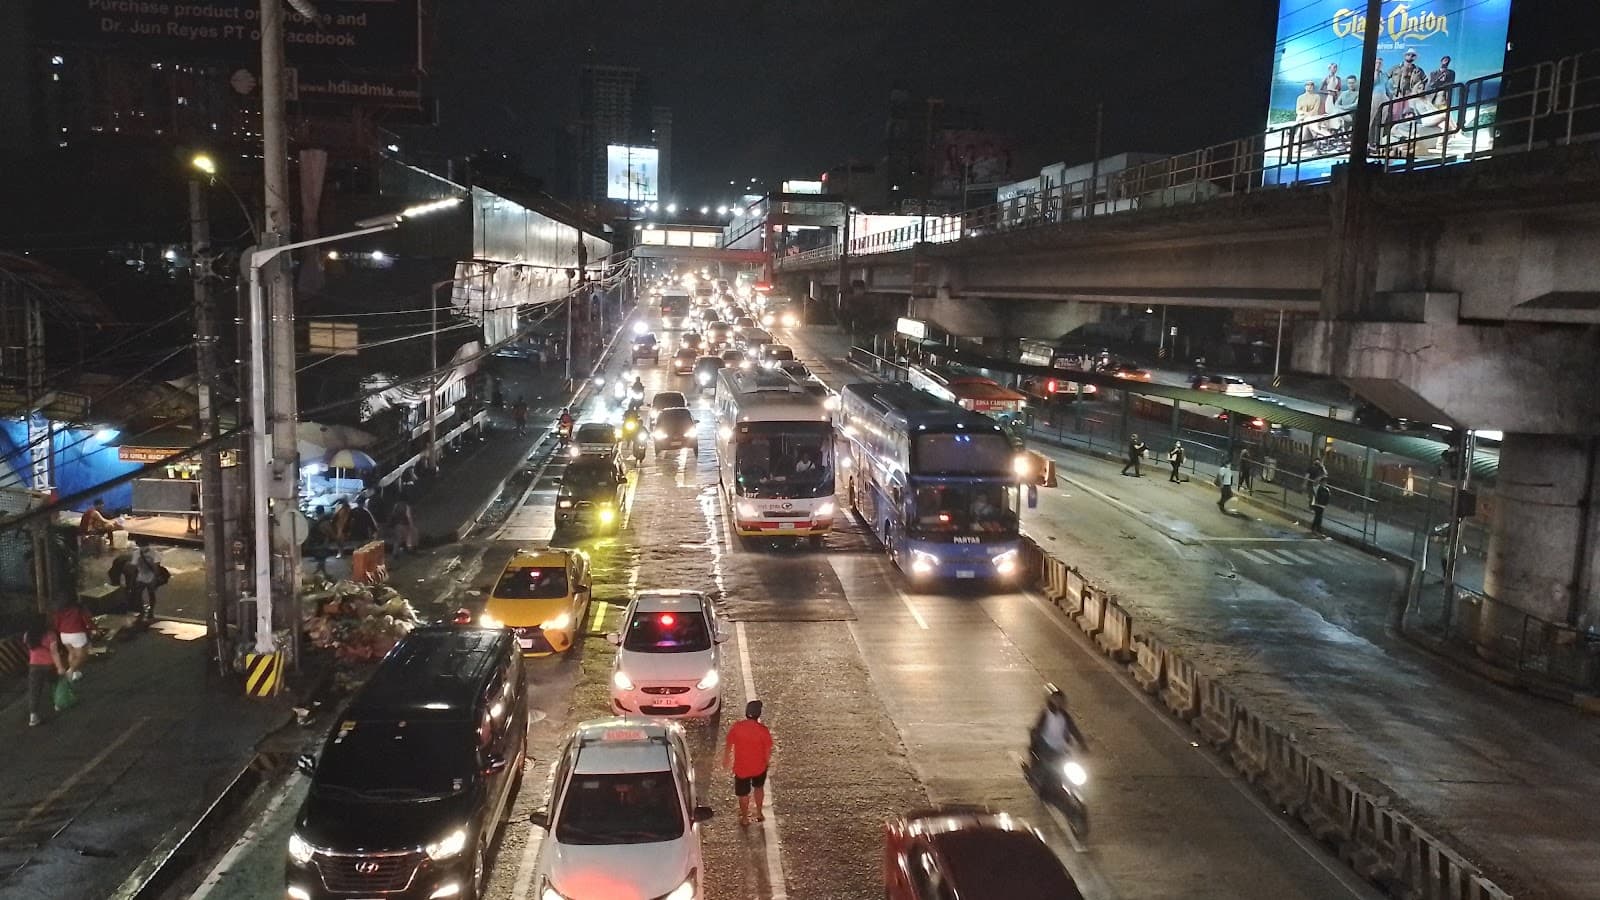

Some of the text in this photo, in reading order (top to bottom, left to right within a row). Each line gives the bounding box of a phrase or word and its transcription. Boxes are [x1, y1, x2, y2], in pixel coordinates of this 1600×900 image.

[88, 0, 169, 15] Purchase
[174, 3, 240, 18] product
[336, 12, 368, 27] and
[1388, 3, 1449, 41] Onion
[100, 17, 125, 32] Dr.
[129, 21, 161, 35] Jun
[166, 22, 218, 40] Reyes
[223, 25, 246, 40] PT
